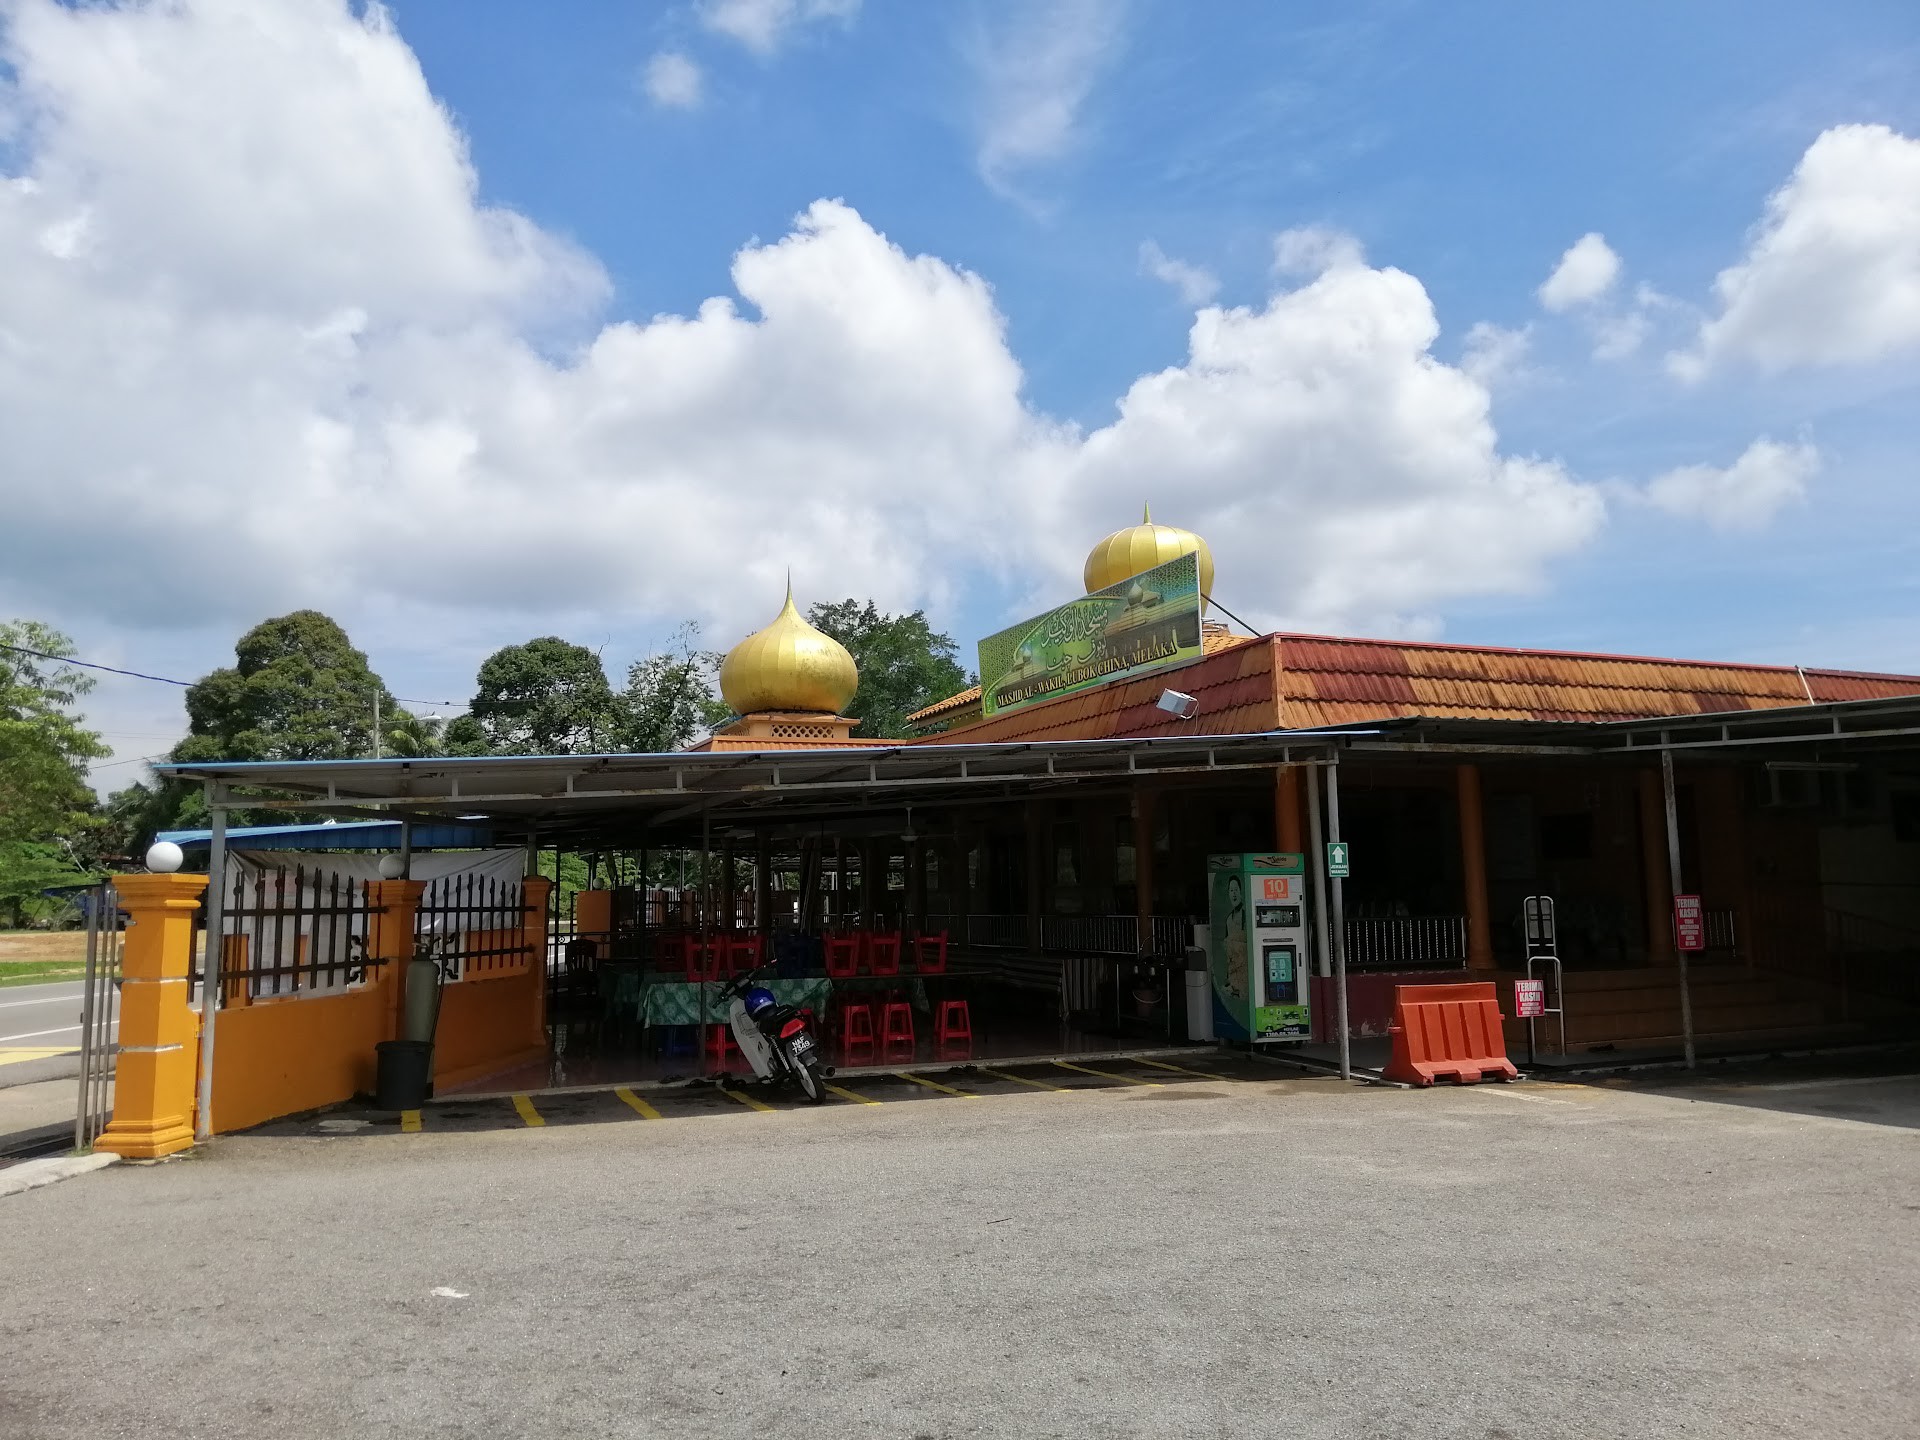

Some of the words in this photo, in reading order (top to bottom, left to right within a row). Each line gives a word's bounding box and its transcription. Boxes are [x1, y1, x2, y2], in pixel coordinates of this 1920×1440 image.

[997, 693, 1024, 707] MASJID
[1024, 686, 1034, 699] AL
[1067, 668, 1097, 686] LUBOK
[1098, 658, 1130, 675] CHINA,
[1132, 642, 1176, 666] MELAKA
[1267, 880, 1284, 893] 10
[1676, 899, 1699, 908] TERIMA
[1679, 908, 1698, 918] KASIH
[1516, 982, 1543, 992] TERIMA
[1519, 992, 1541, 1002] KASIH
[792, 1036, 805, 1048] NAF
